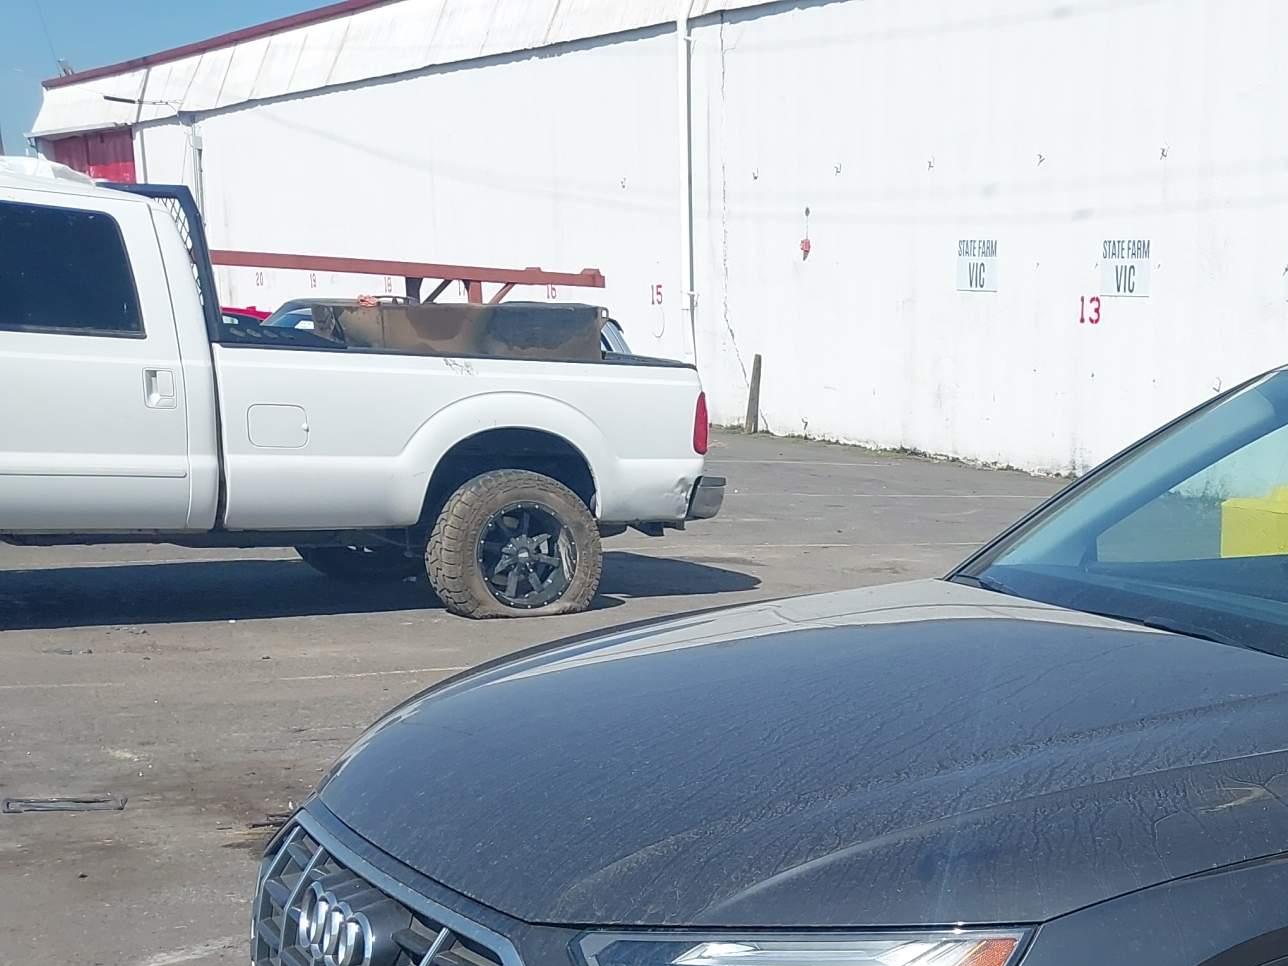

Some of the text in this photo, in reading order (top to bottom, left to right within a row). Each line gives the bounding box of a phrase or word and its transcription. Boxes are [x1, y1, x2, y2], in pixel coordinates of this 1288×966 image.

[958, 240, 997, 257] STATE FARM
[1103, 240, 1150, 259] STATE FARM
[968, 262, 985, 288] VIC
[1115, 265, 1135, 293] VIC
[651, 284, 663, 305] 15
[1080, 296, 1101, 325] 13
